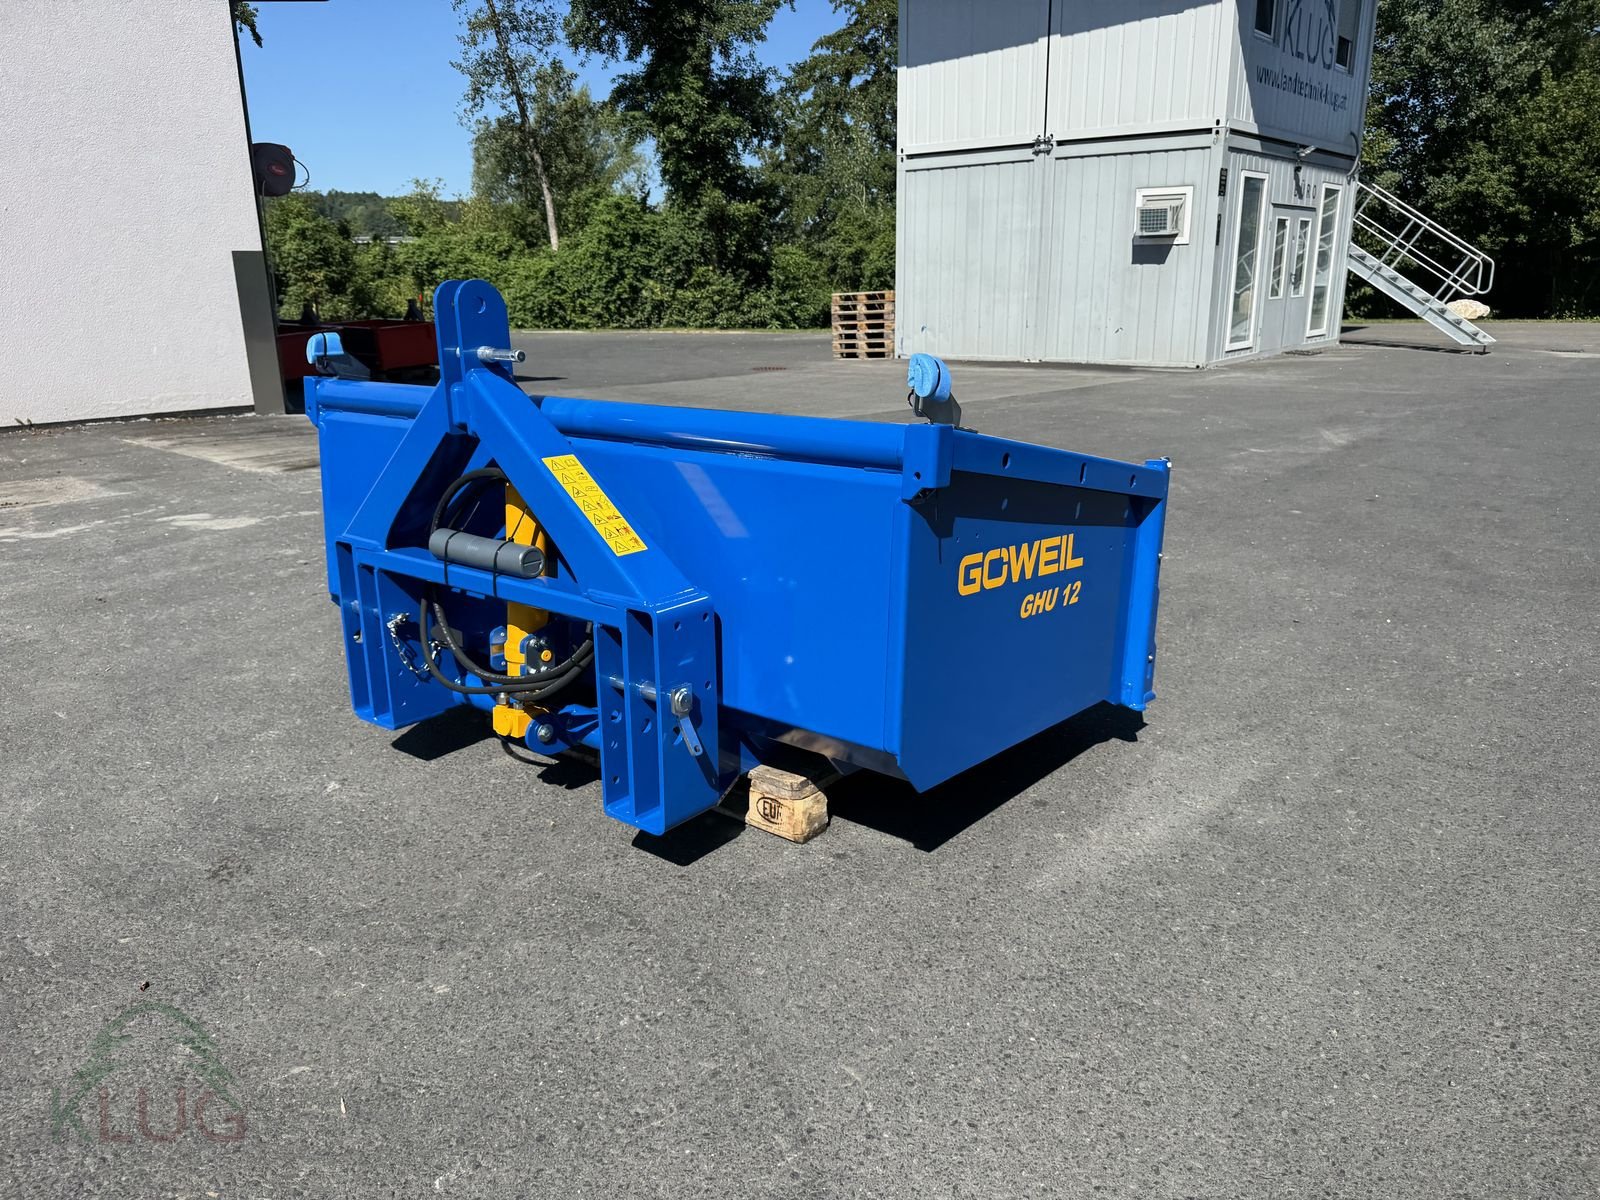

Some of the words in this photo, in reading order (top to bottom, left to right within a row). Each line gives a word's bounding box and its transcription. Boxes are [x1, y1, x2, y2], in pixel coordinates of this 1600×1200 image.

[1283, 0, 1334, 70] KLUG
[1020, 586, 1060, 619] GHU
[1062, 580, 1082, 607] 12
